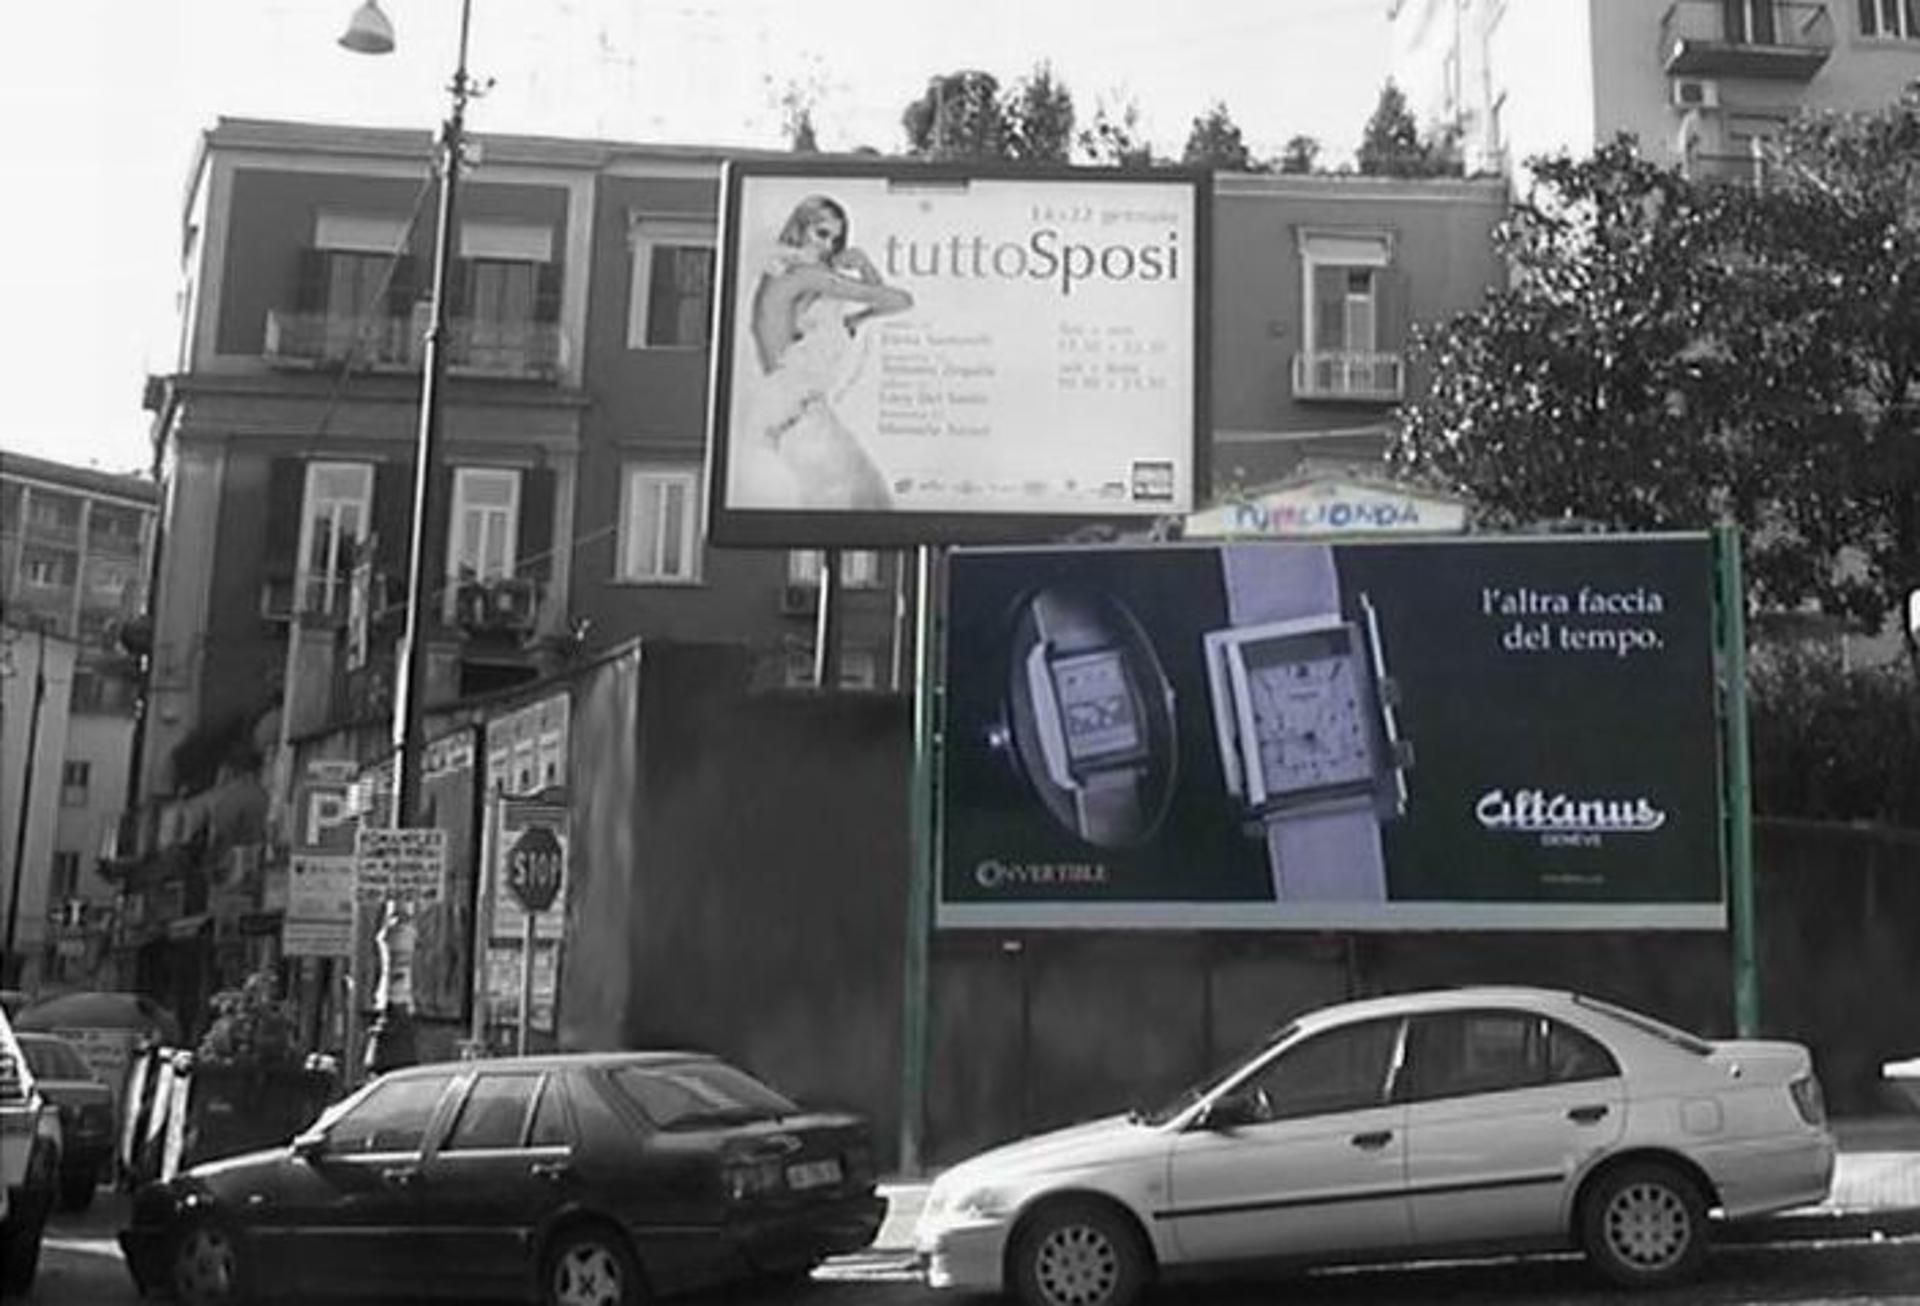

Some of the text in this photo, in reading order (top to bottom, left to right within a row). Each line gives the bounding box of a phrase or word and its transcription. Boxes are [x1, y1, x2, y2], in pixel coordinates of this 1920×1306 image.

[886, 229, 1178, 295] tuttoSposi
[1483, 585, 1663, 615] l'altra faccia
[1503, 622, 1664, 657] del tempo.
